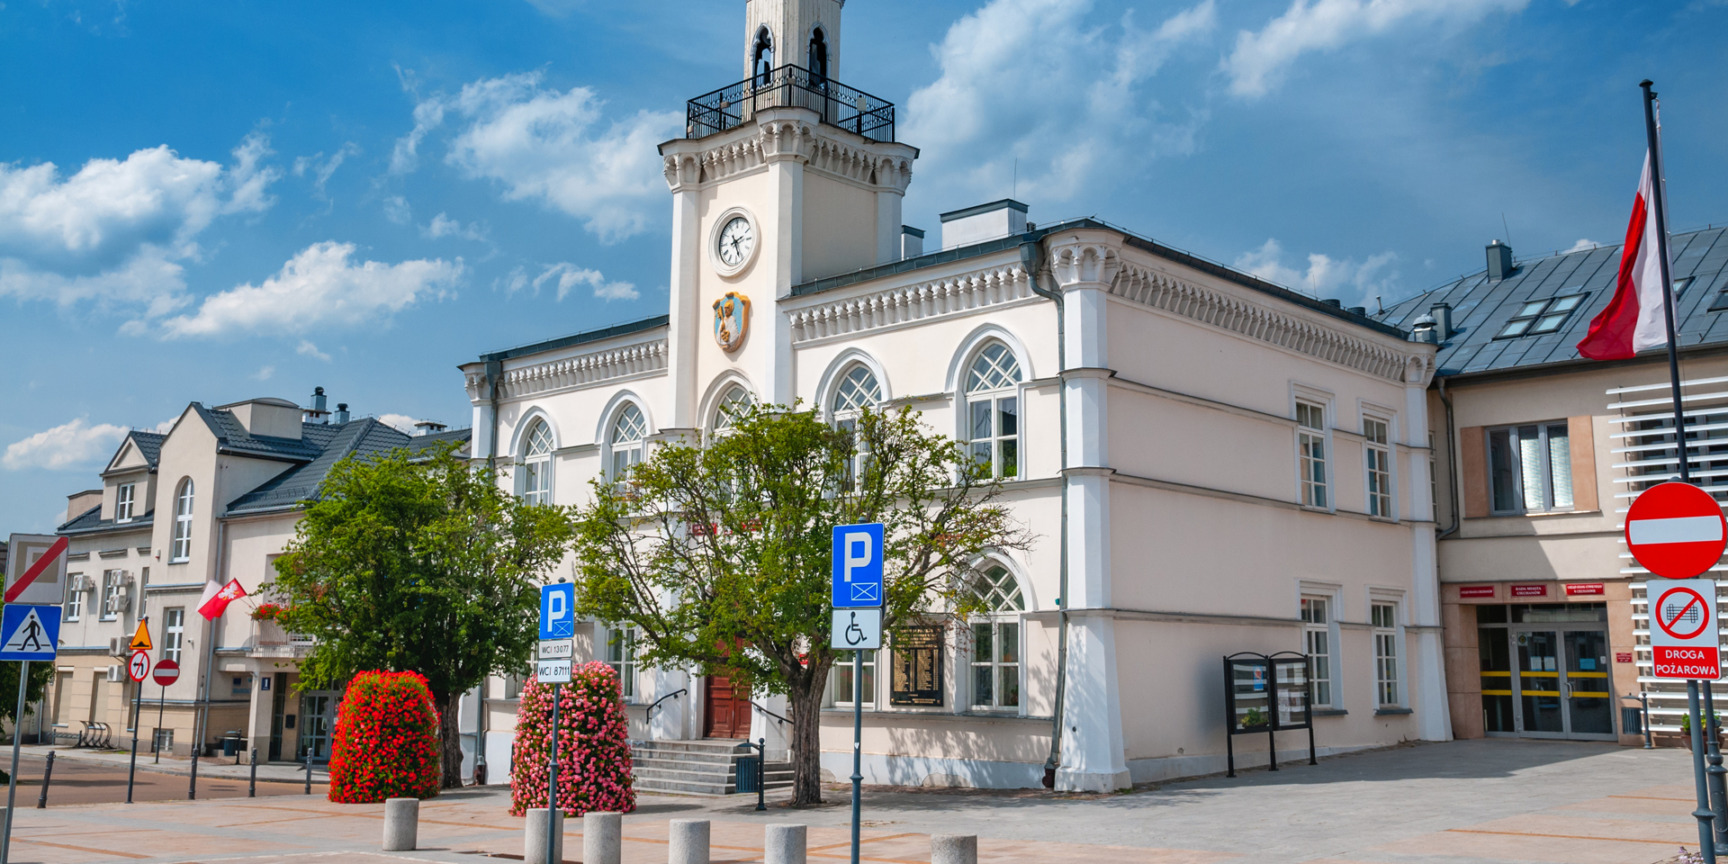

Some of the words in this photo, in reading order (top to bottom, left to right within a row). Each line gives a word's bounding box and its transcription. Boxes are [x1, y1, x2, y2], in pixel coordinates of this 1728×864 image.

[844, 532, 872, 582] P
[547, 590, 566, 632] P
[1665, 649, 1705, 659] DROGA
[539, 667, 552, 676] WCI
[1656, 662, 1717, 675] POŻAROWA
